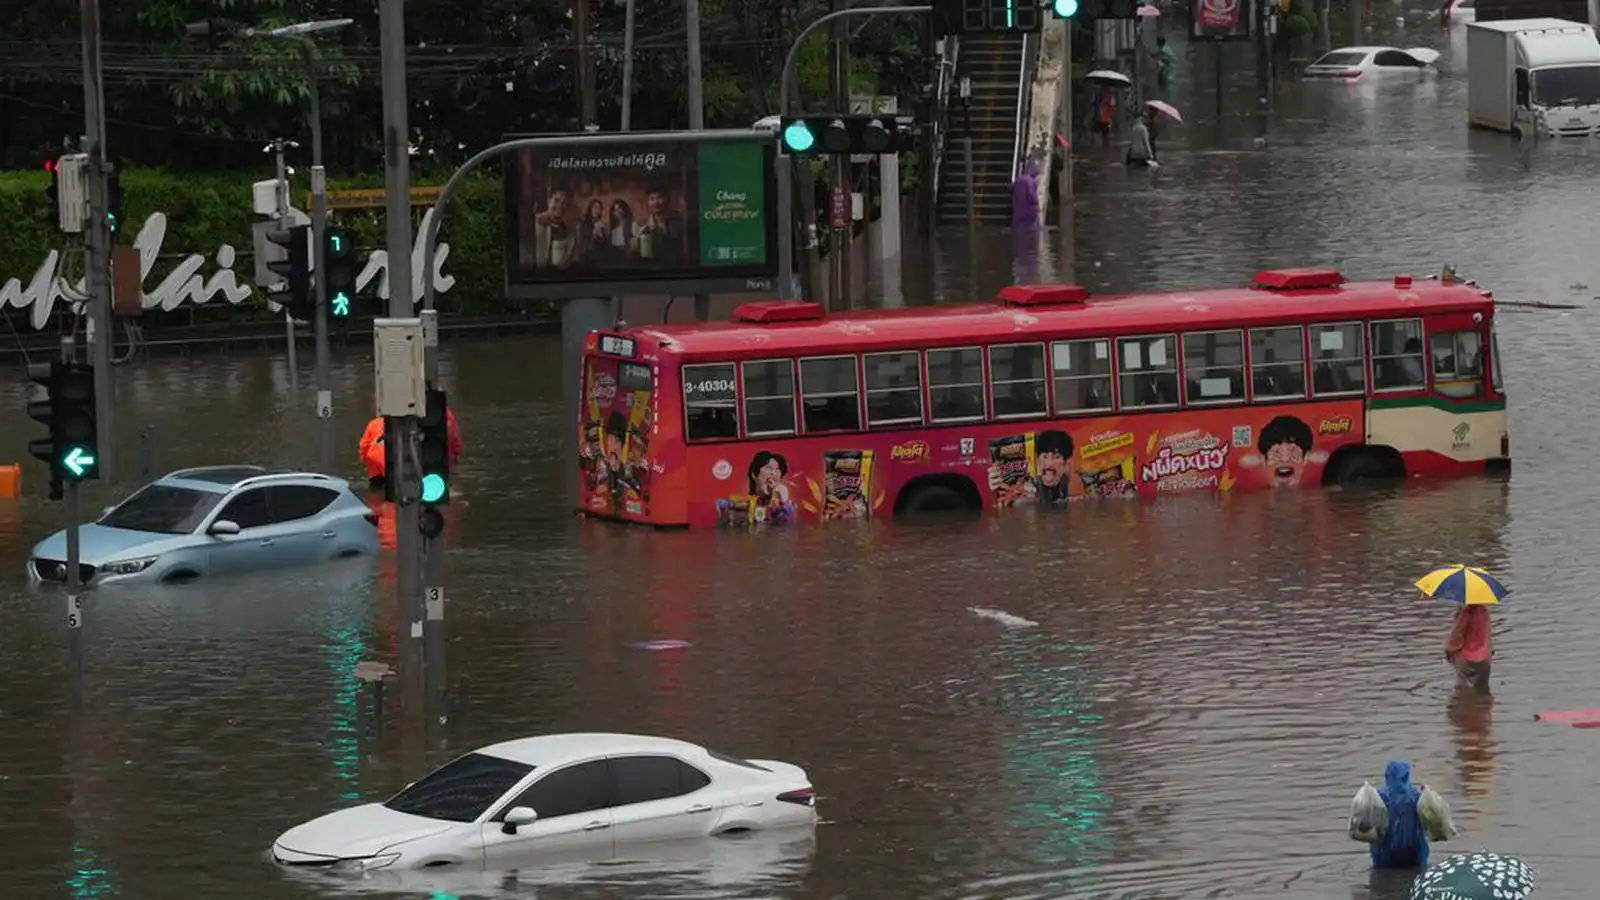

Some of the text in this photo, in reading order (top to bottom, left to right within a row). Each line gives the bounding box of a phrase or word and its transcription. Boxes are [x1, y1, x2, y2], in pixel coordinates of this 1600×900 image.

[716, 190, 747, 202] Chang
[330, 235, 340, 251] 7
[322, 406, 329, 416] 6
[430, 588, 439, 600] 3
[69, 614, 76, 626] 5
